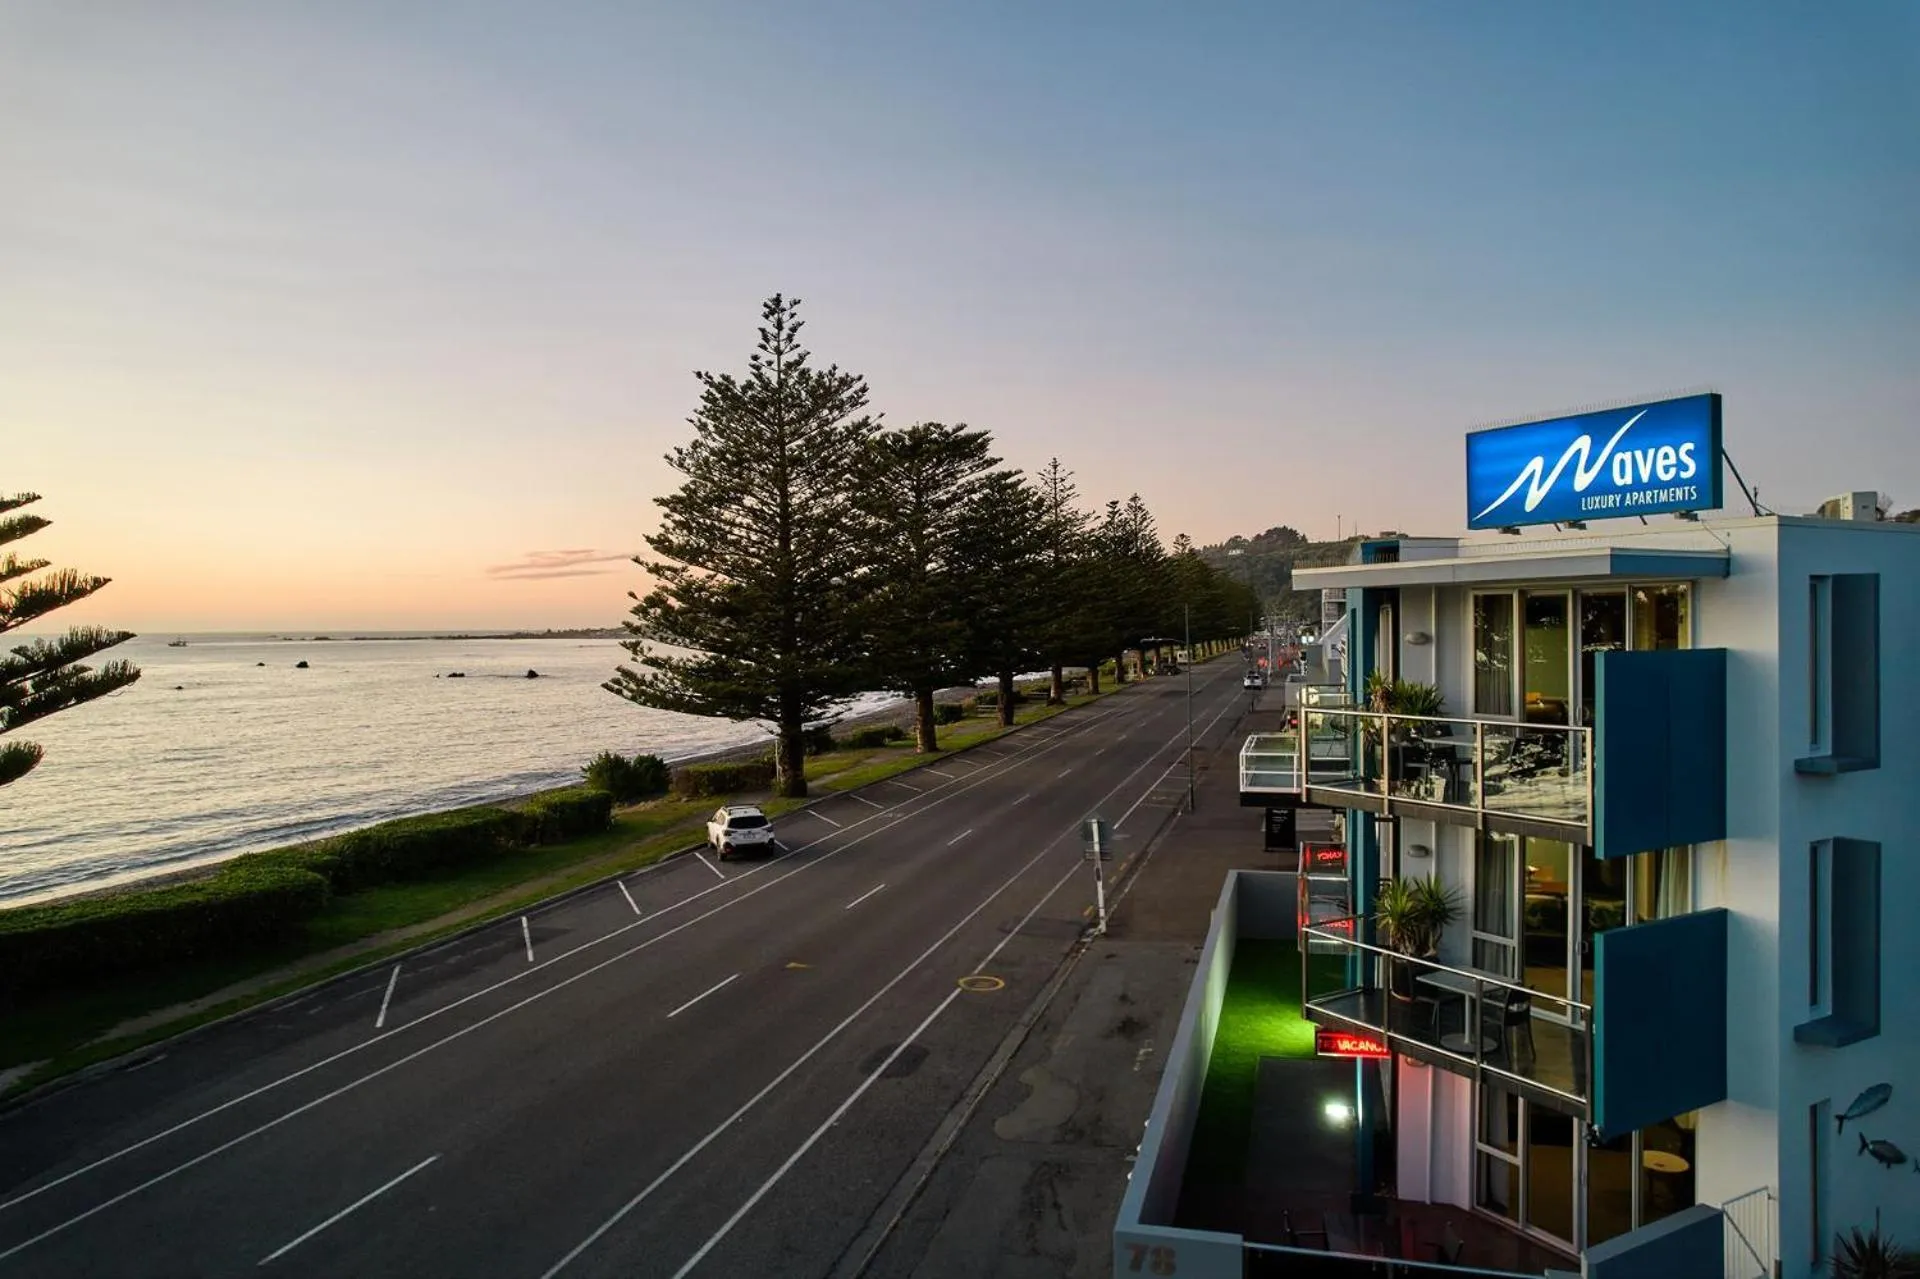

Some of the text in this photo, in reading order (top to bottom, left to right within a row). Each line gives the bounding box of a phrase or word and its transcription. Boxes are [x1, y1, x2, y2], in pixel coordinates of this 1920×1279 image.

[1473, 409, 1697, 520] Waves
[1581, 485, 1697, 511] LUXURY APARTMENTS
